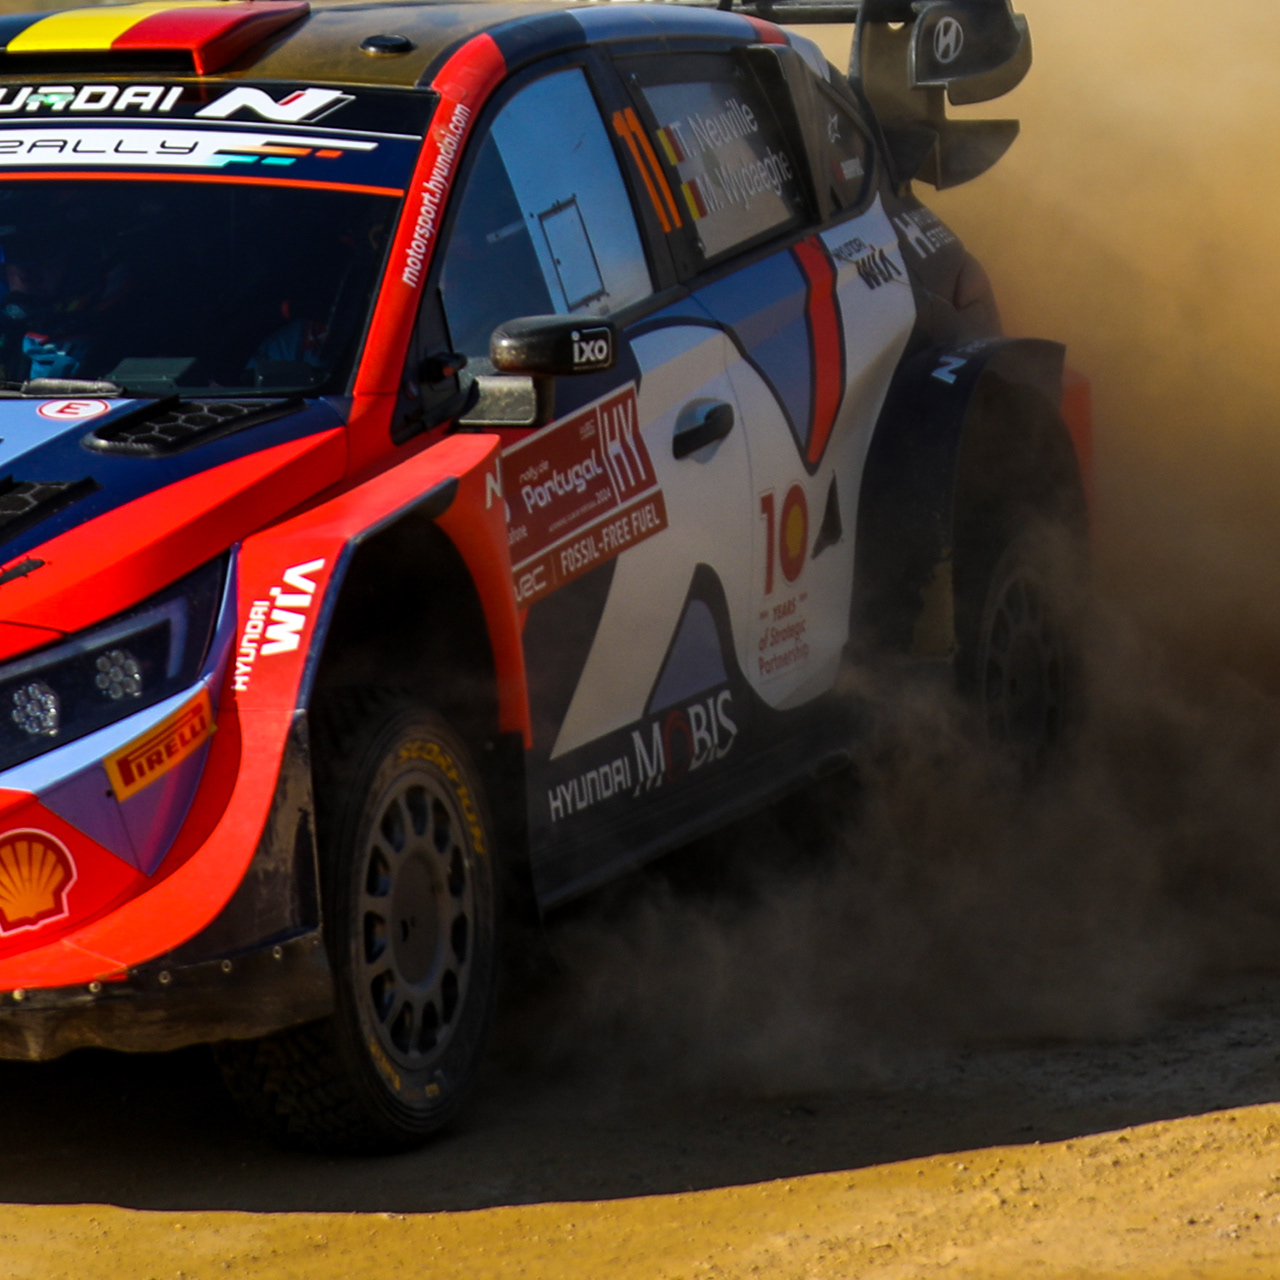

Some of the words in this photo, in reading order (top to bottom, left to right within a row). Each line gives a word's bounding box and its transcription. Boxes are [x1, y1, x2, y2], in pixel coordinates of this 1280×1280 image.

[670, 121, 697, 159] T.
[687, 98, 759, 152] Neuville
[402, 103, 471, 288] motorsport.hyundai.com
[613, 107, 682, 233] 11
[713, 146, 793, 211] Wydaeghe
[855, 244, 902, 290] WIA
[571, 331, 608, 363] ixo
[56, 402, 93, 415] E
[603, 398, 647, 493] HY
[521, 449, 603, 514] Portugal
[560, 516, 632, 575] FOSSIL-FREE
[631, 502, 661, 537] FUEL
[760, 484, 809, 595] 10
[231, 600, 270, 692] HYUNDAI
[260, 558, 325, 656] WIA
[116, 702, 207, 788] PIRELLI
[631, 689, 738, 798] MOBIS
[548, 756, 632, 822] HYUNDAI
